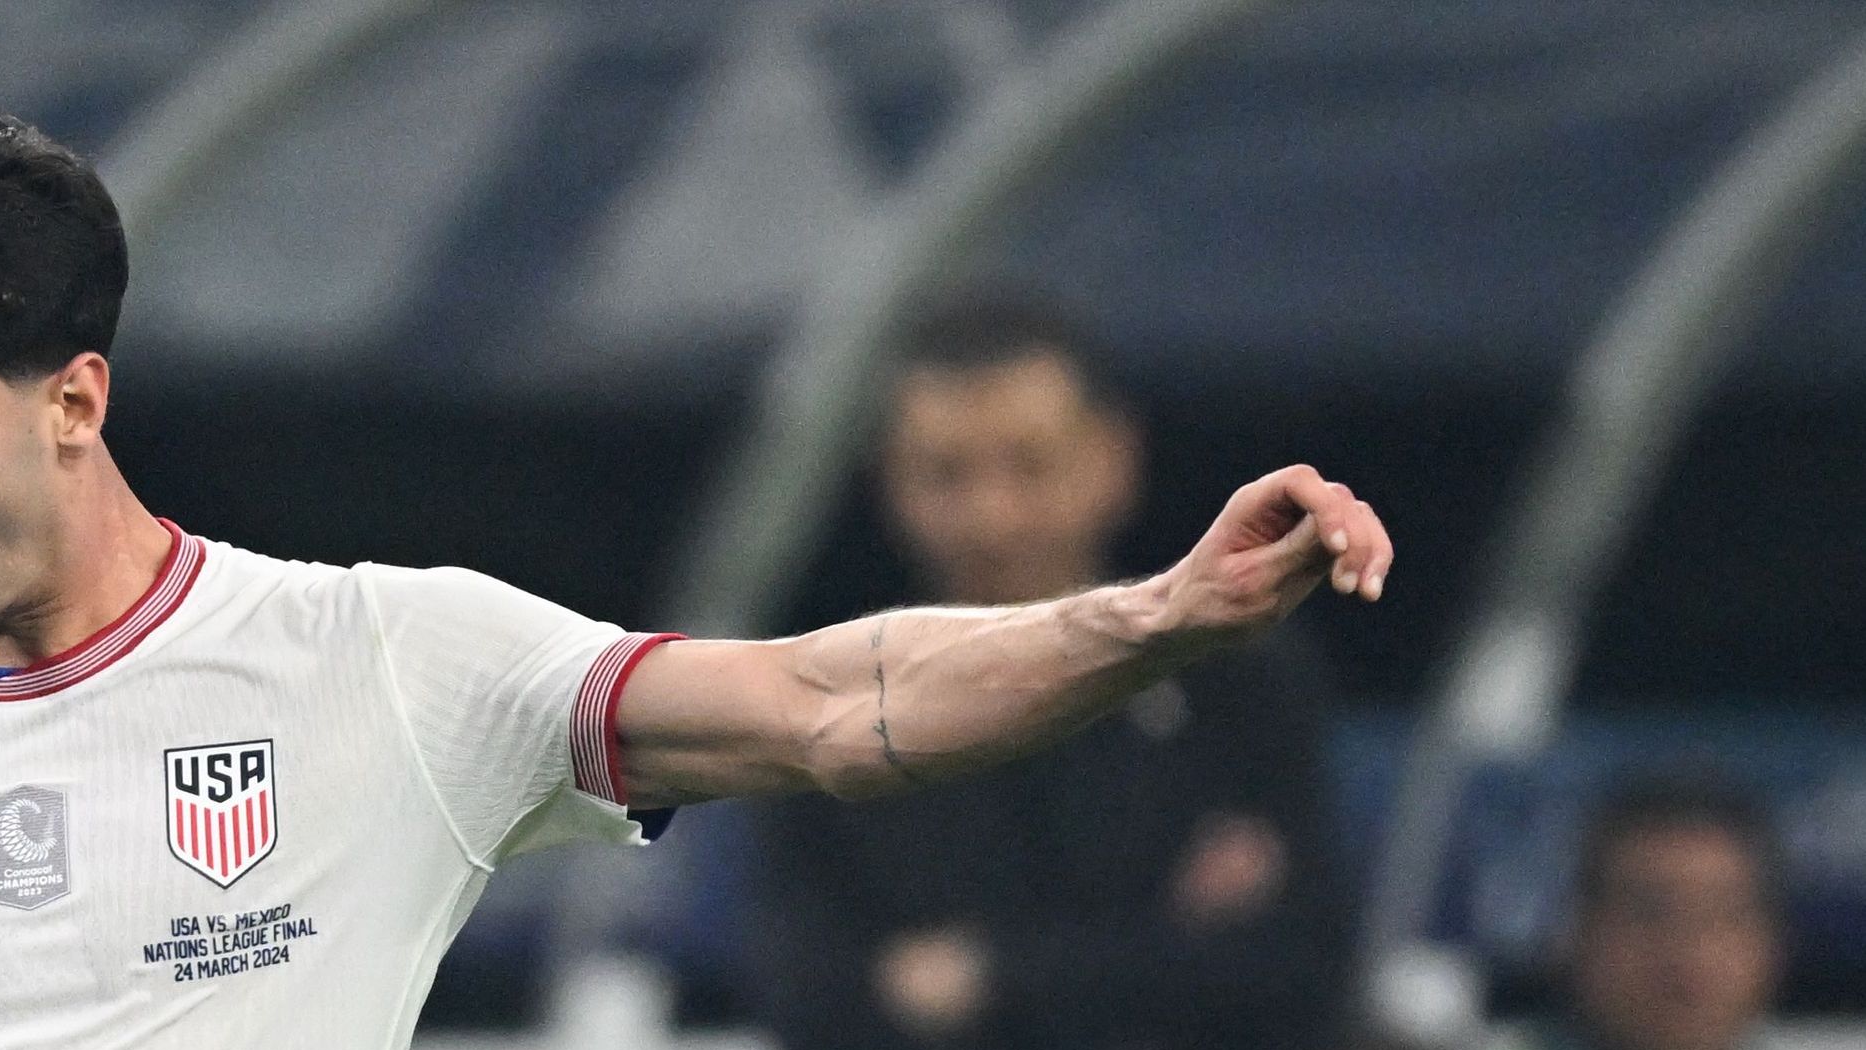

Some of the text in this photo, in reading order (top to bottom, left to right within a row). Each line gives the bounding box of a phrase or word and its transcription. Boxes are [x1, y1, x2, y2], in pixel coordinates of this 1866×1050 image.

[174, 749, 266, 803] USA
[143, 917, 317, 963] NATIONS LEAGUE FINAL
[171, 903, 291, 937] USA VS. MEXICO
[174, 945, 290, 982] 24 MARCH 2024
